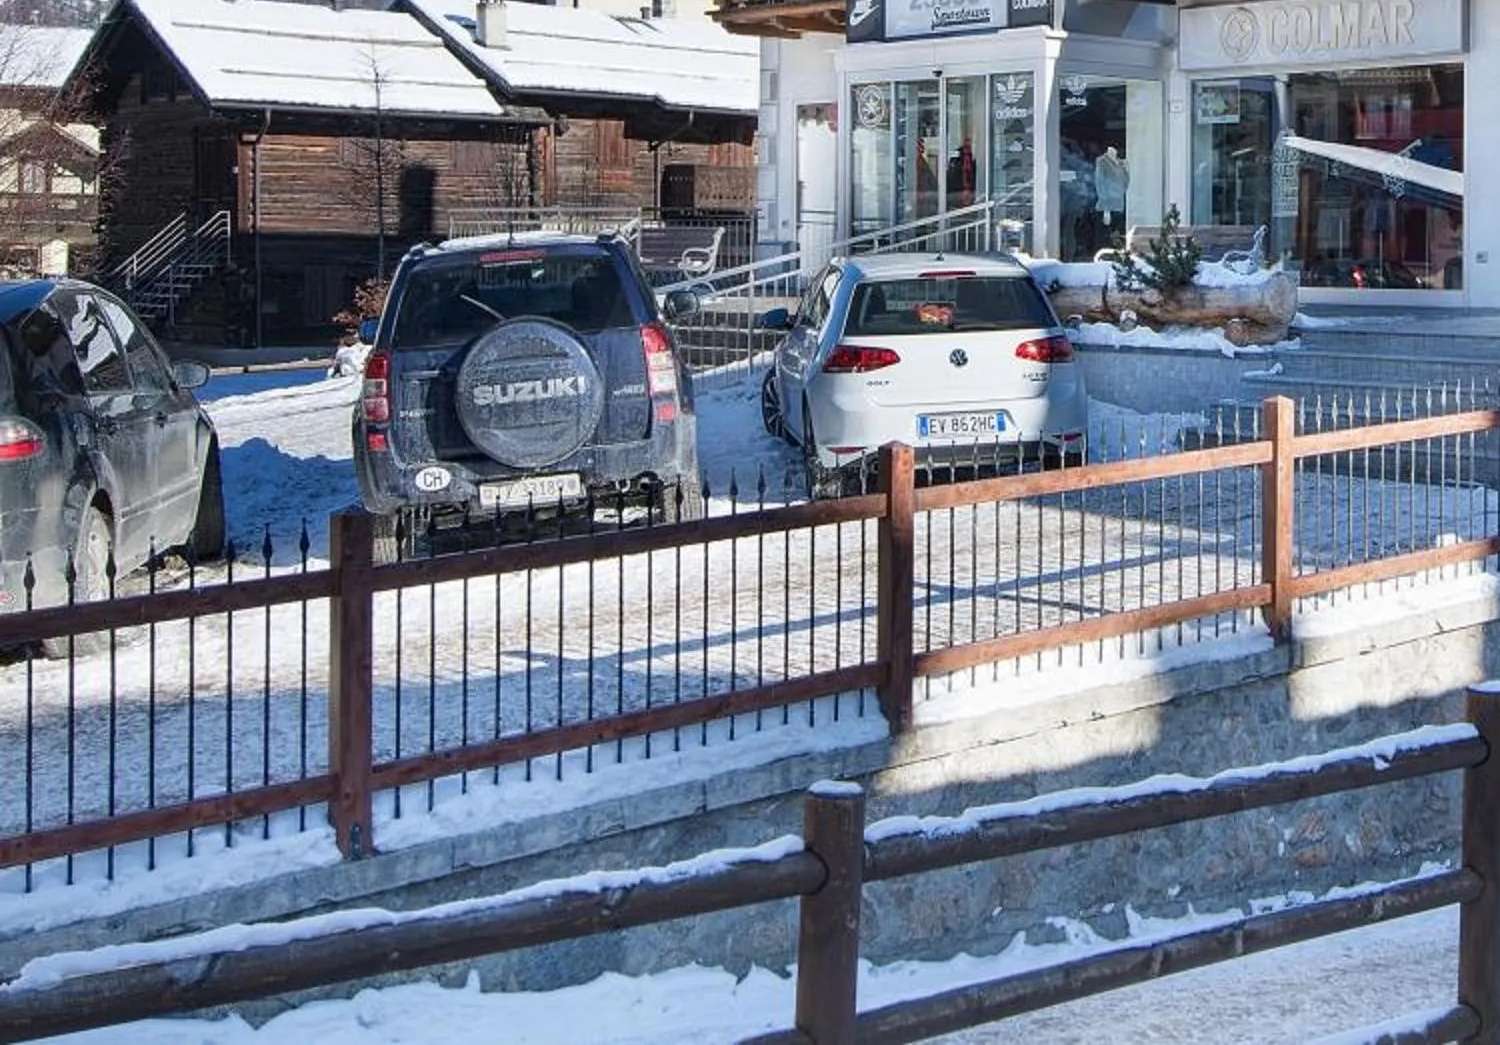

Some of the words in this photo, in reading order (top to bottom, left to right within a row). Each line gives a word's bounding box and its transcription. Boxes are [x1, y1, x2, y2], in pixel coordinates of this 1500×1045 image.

[995, 106, 1028, 119] adidas
[473, 376, 585, 405] SUZUKI
[423, 472, 443, 487] CH
